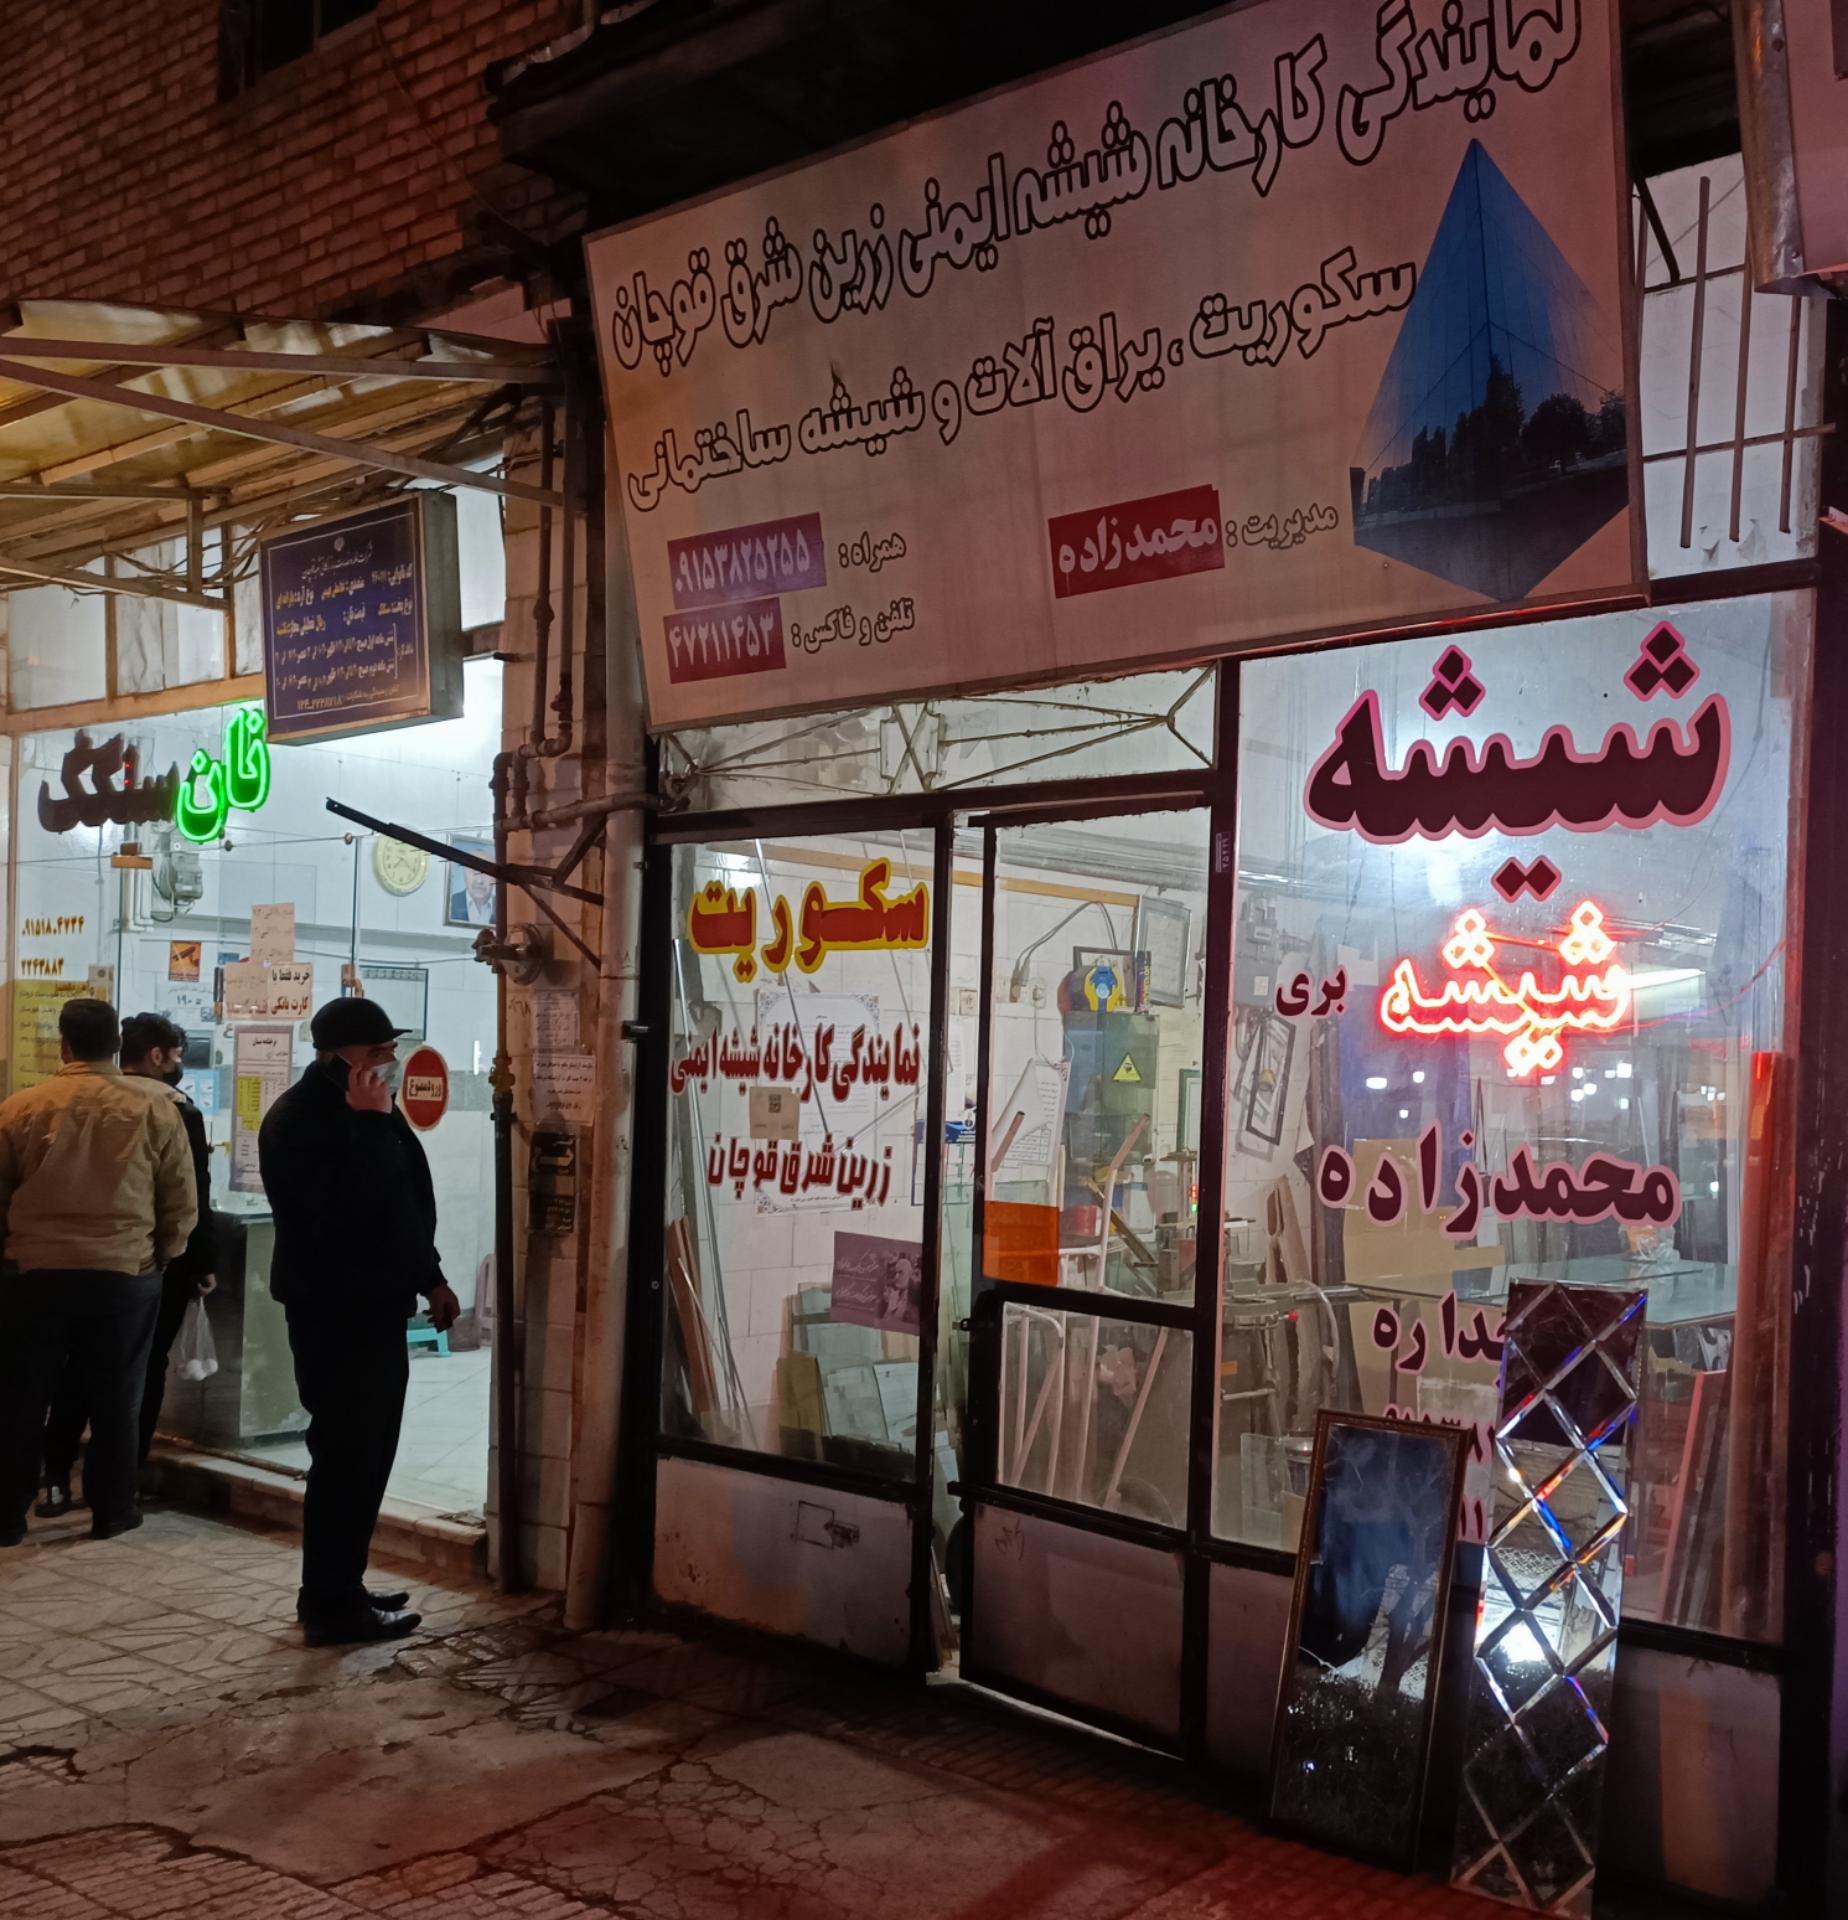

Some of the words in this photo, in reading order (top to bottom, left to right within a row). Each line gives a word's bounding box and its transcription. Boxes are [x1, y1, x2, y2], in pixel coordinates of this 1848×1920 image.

[1156, 33, 1327, 197] کارخانه
[1012, 100, 1152, 240] شیشه
[808, 203, 895, 323] زرین
[899, 152, 1010, 297] ایمنی
[612, 247, 716, 377] قوچان
[720, 216, 804, 348] شرق
[799, 368, 926, 456] شیشه
[931, 380, 963, 445] و
[965, 316, 1058, 416] آلات
[1062, 312, 1166, 413] یراق
[627, 408, 792, 512] ساختمانی
[1058, 514, 1219, 574] محمدزاده
[668, 611, 774, 669] ۴۷۲۱۱۴۵۳
[859, 616, 873, 647] و
[874, 597, 916, 644] تلفن
[37, 728, 180, 835] سنگک
[176, 707, 271, 844] نان
[1304, 620, 1732, 904] شیشه
[687, 856, 930, 984] سکوریت
[1275, 964, 1350, 1020] بری
[1378, 900, 1634, 1078] شیشه
[670, 1024, 719, 1096] ایمنی
[719, 1024, 761, 1097] شیشه
[763, 1022, 835, 1103] کارخانه
[832, 1022, 922, 1101] نمایندگی
[706, 1132, 778, 1201] قوچان
[779, 1132, 837, 1196] شرق
[836, 1135, 893, 1211] زرین
[1315, 1119, 1682, 1240] محمدزاده
